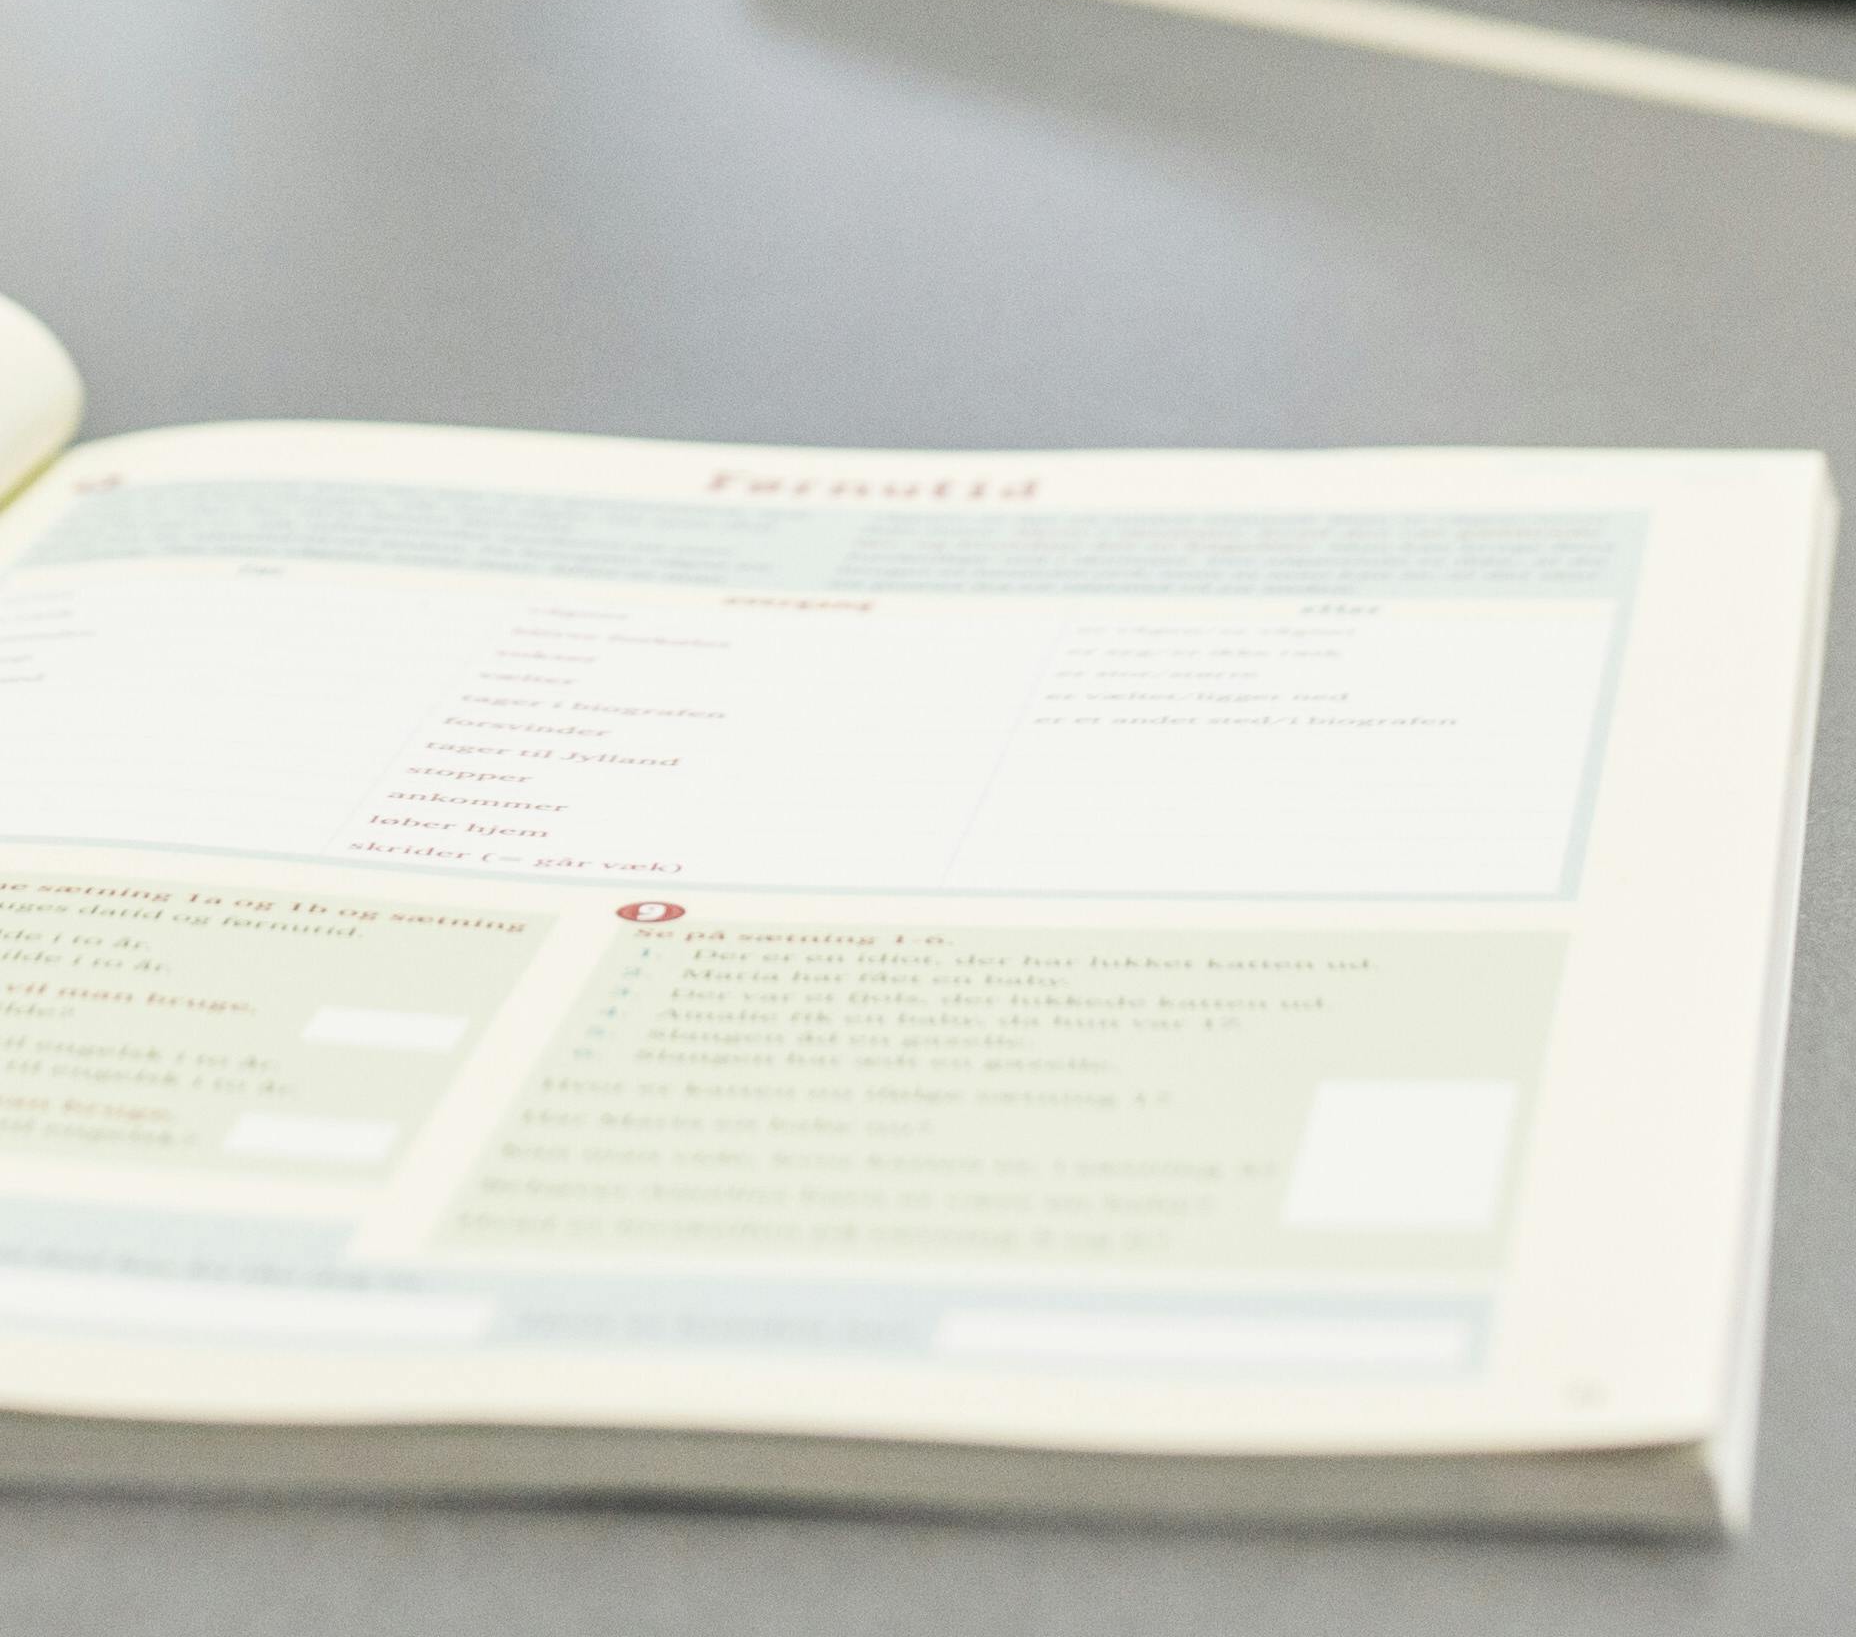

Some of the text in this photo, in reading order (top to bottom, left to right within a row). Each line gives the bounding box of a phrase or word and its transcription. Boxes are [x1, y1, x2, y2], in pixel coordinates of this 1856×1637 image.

[461, 693, 542, 710] tager
[572, 701, 727, 721] biografen
[443, 715, 612, 738] forsvinder
[424, 740, 682, 768] tager til Jylland
[405, 766, 534, 784] stopper
[386, 790, 569, 812] ankommer
[368, 814, 549, 839] løber hjem
[348, 841, 472, 860] skrider
[533, 856, 593, 869] går
[602, 861, 683, 874] væk)
[38, 883, 172, 903] sætning
[188, 892, 223, 906] 1a
[233, 897, 277, 912] og
[292, 901, 329, 915] 1b
[338, 907, 380, 923] og
[390, 911, 528, 934] sætning
[171, 912, 211, 927] og
[684, 929, 727, 944] på
